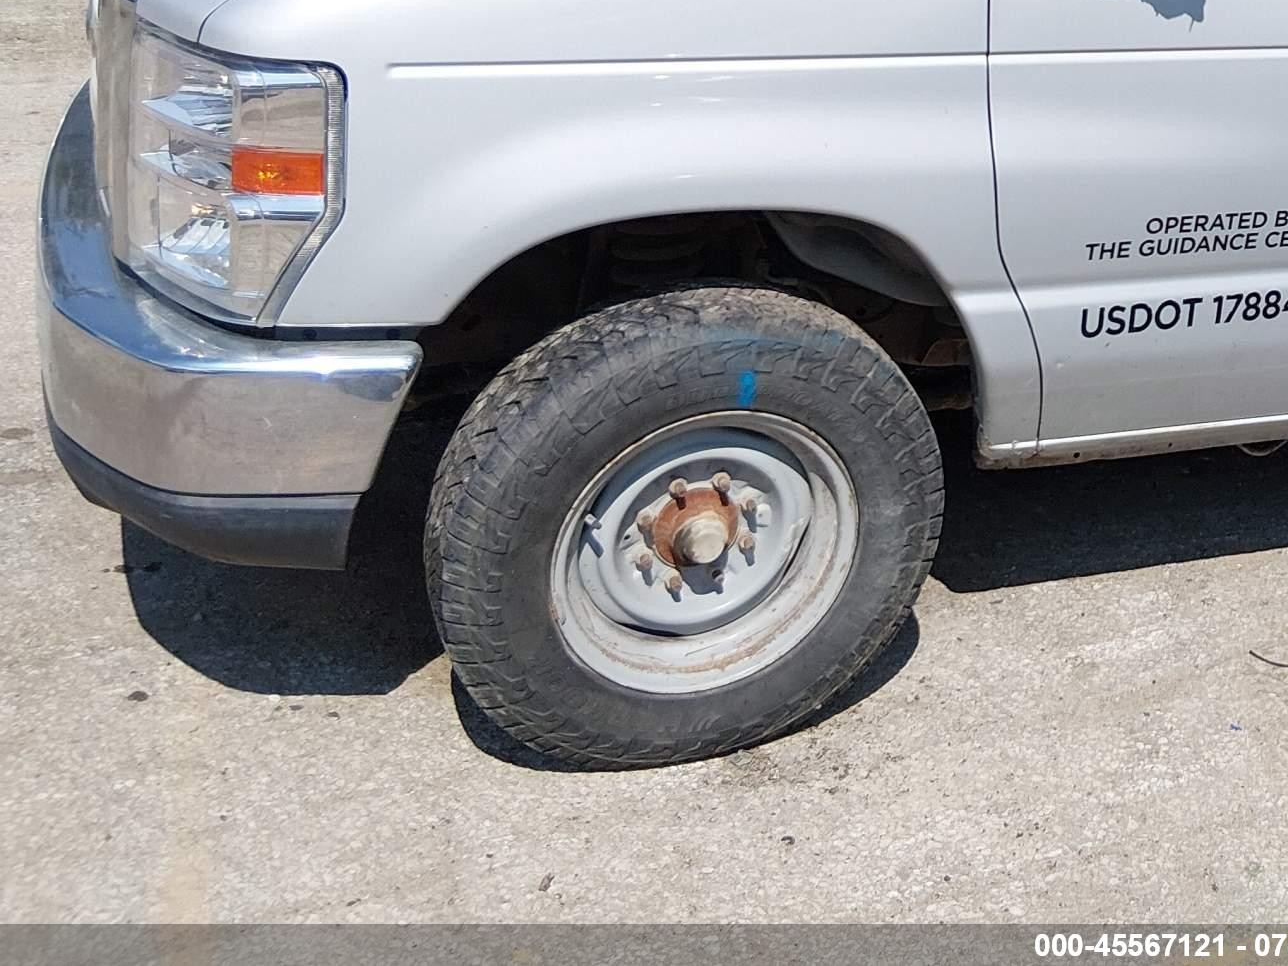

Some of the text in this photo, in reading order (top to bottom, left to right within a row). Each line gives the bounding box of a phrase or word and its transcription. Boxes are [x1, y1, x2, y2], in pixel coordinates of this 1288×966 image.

[1146, 211, 1268, 235] OPERATED
[1085, 240, 1132, 261] THE
[1138, 232, 1260, 257] GUIDANCE
[1080, 297, 1204, 339] USDOT
